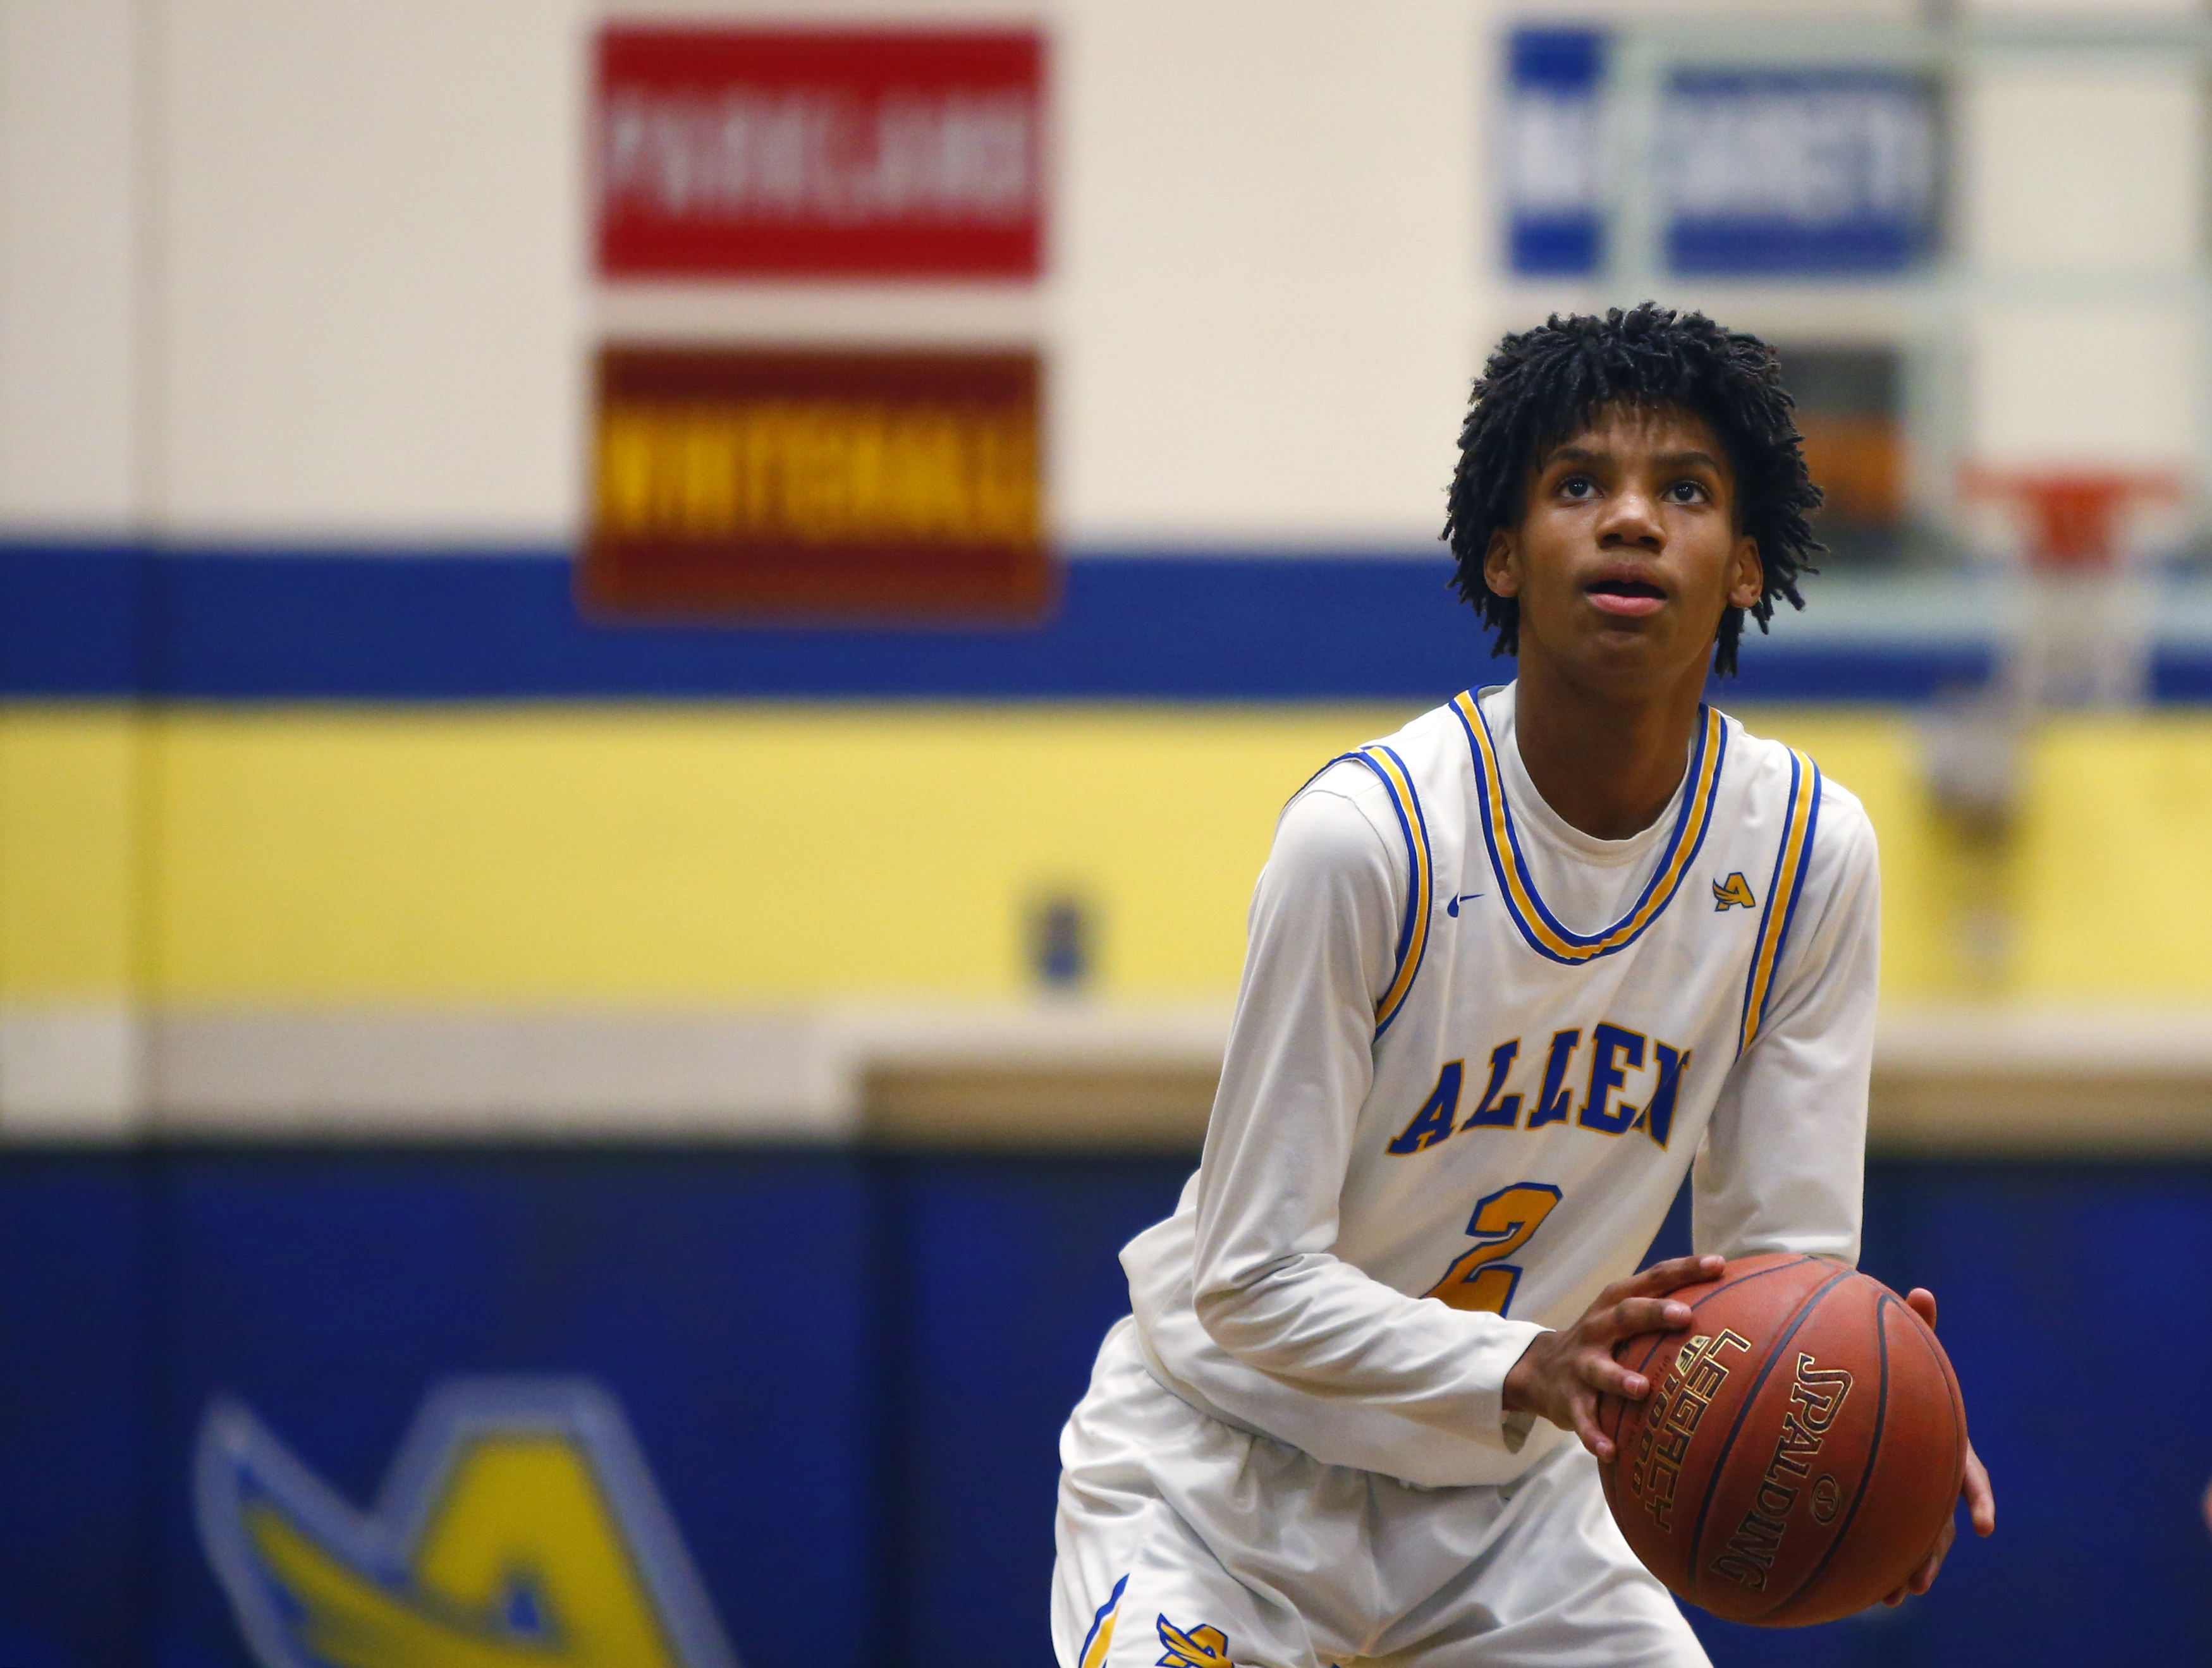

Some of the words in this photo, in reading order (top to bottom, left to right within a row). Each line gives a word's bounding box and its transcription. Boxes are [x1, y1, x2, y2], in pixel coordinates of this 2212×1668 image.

[1385, 1021, 1692, 1157] ALLEN
[1419, 1182, 1564, 1320] 2
[1645, 1328, 1752, 1533] LEGACY
[1708, 1352, 1853, 1592] SPALDING
